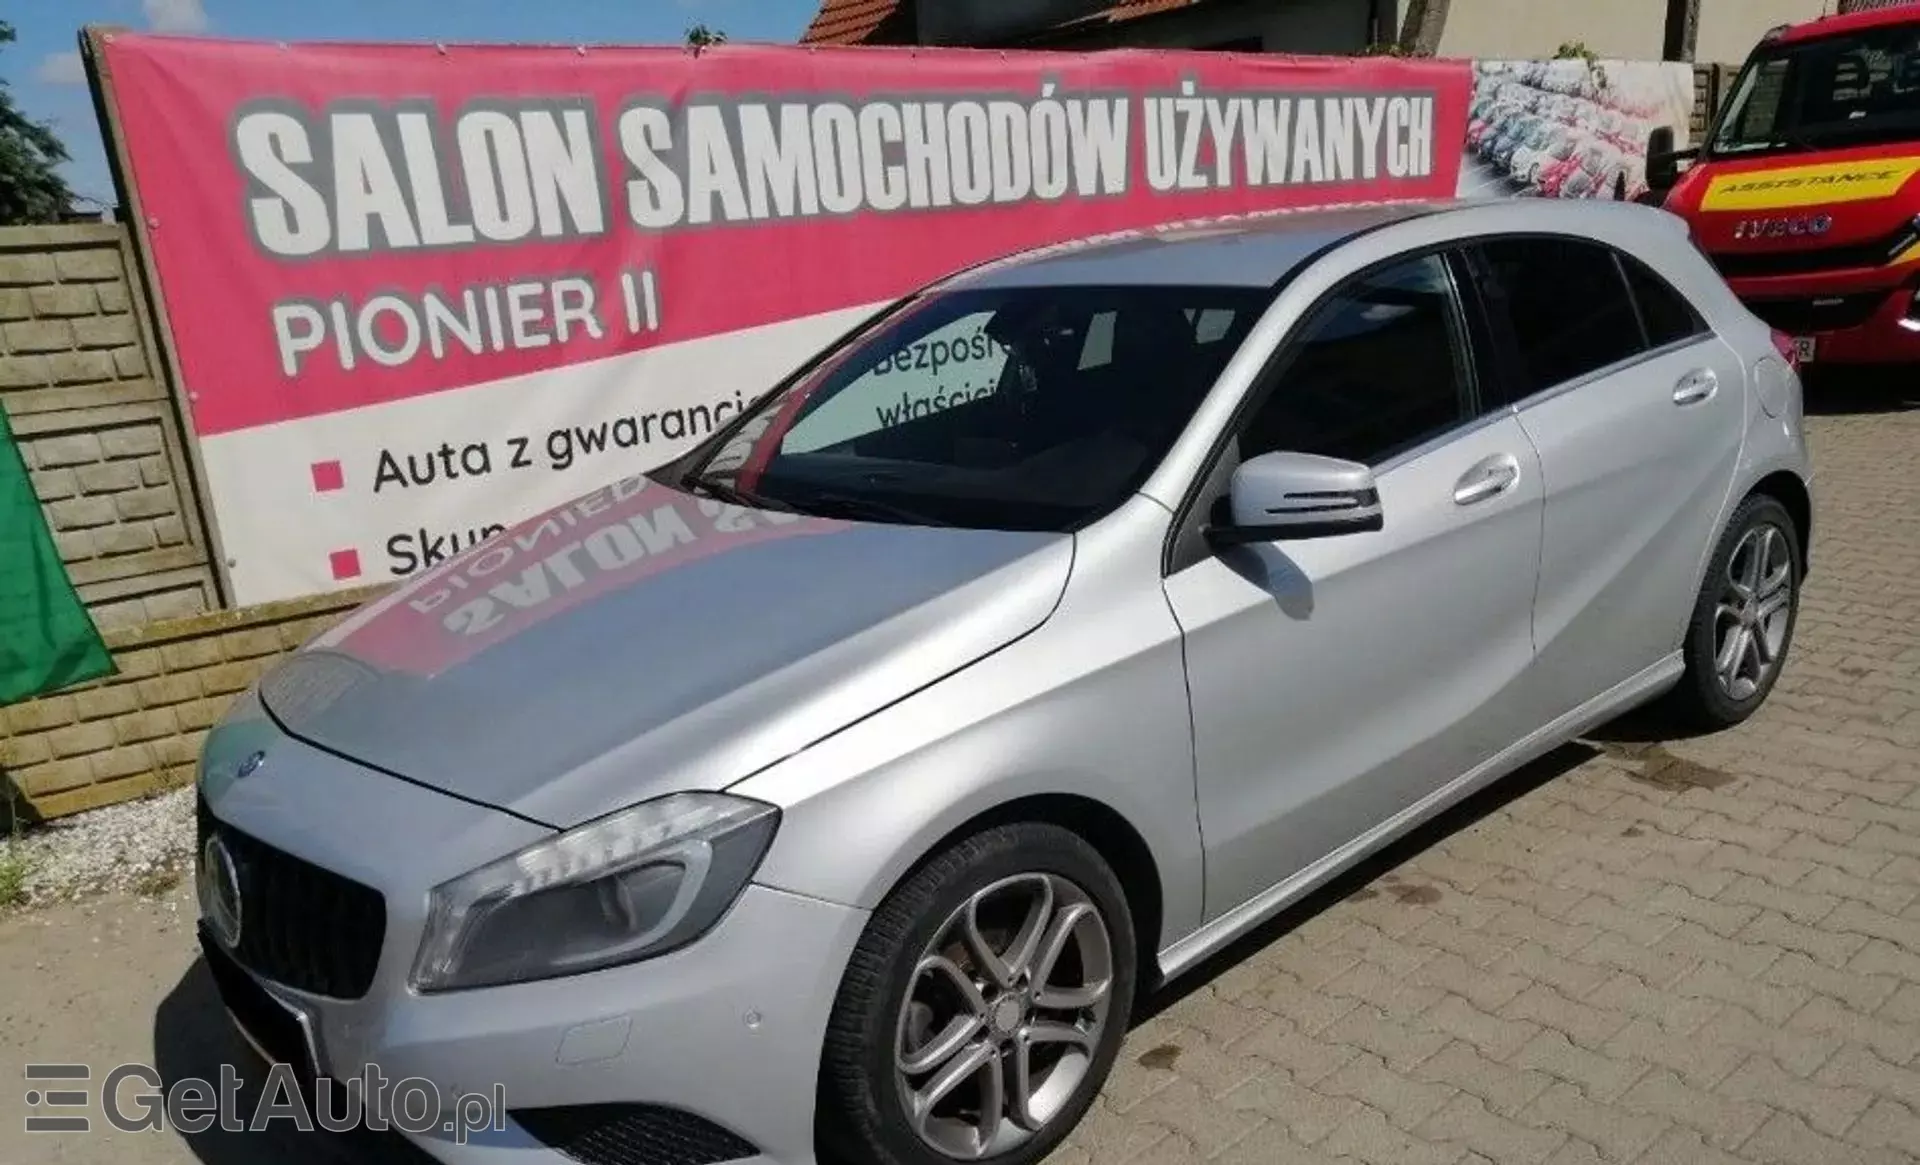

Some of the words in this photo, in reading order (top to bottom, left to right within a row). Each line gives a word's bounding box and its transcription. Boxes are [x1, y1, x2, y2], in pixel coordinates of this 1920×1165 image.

[236, 109, 605, 256] SALON
[618, 82, 1130, 229] SAMOCHODÓW
[1143, 80, 1434, 191] UŻYWANYCH
[1734, 213, 1833, 240] IVECO
[272, 277, 604, 378] PIONIER
[621, 270, 659, 334] II
[373, 441, 493, 494] Auta
[506, 436, 533, 469] z
[546, 390, 759, 471] gwaranc
